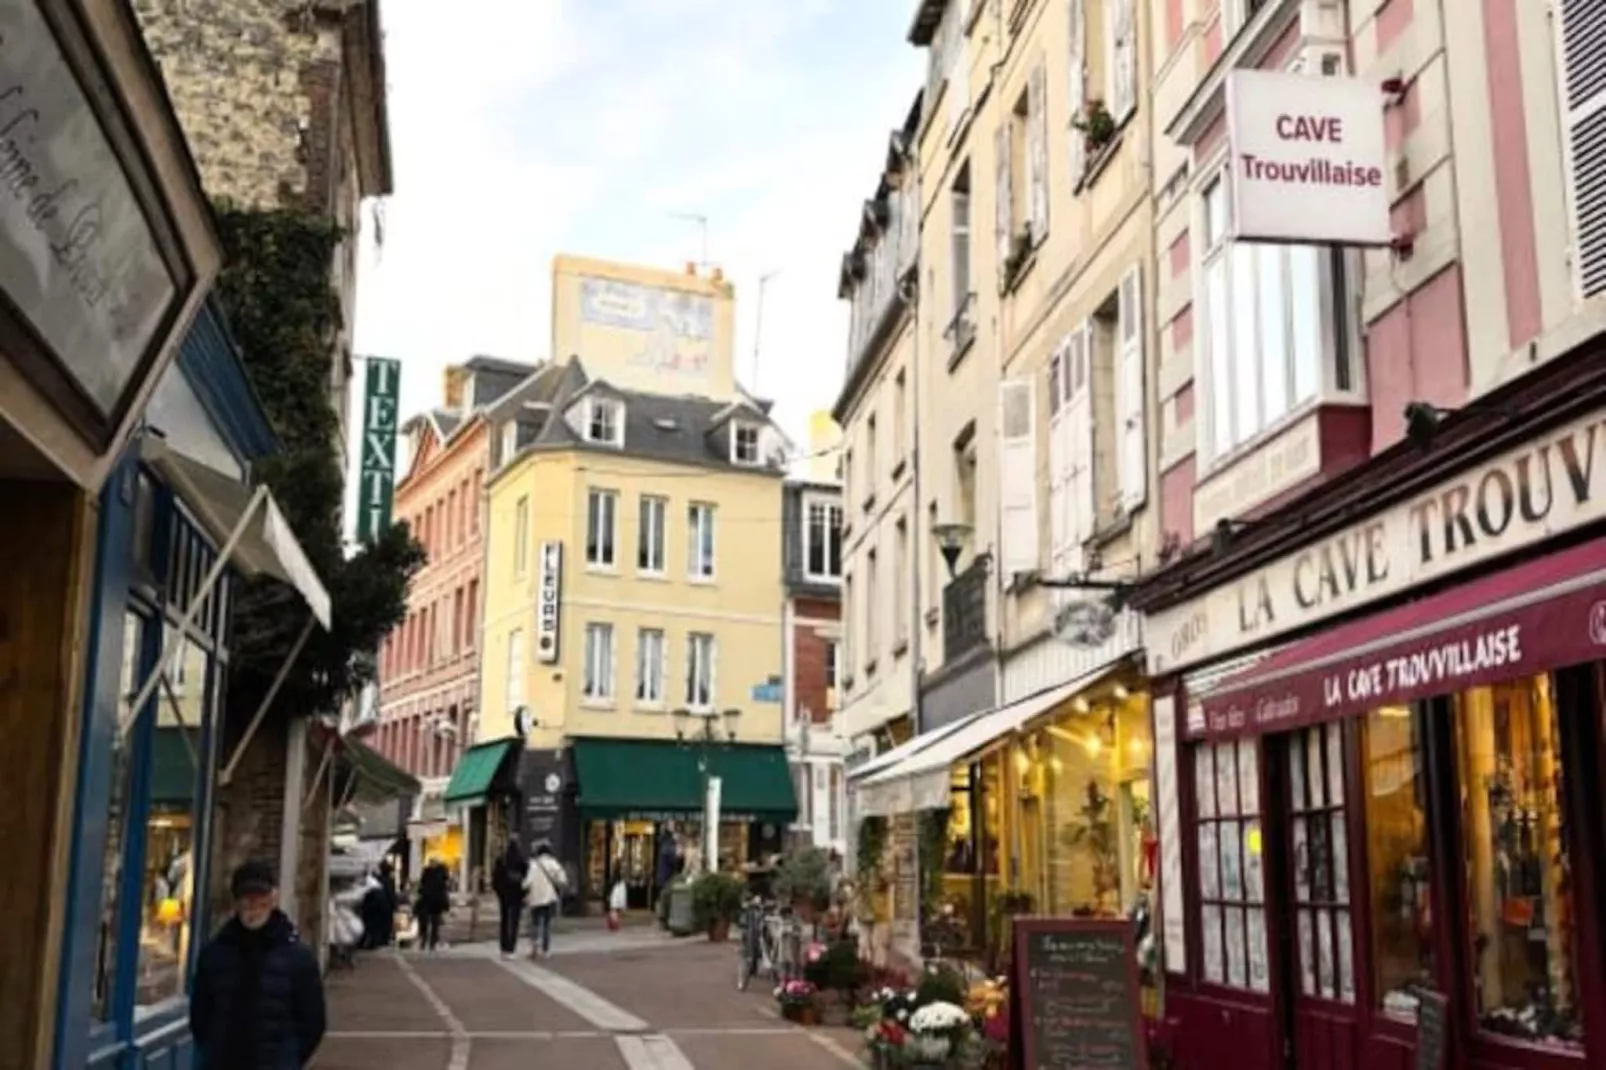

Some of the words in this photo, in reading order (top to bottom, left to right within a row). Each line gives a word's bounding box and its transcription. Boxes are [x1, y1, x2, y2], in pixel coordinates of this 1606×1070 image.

[1276, 114, 1342, 142] CAVE
[1241, 154, 1382, 186] Trouvillaise
[1238, 568, 1275, 632] LA
[1293, 521, 1389, 609] CAVE
[1410, 418, 1606, 564] TROUV
[1324, 675, 1343, 708] LA
[1348, 663, 1383, 701] CAVE
[1385, 624, 1522, 692] TROUVILLAISE
